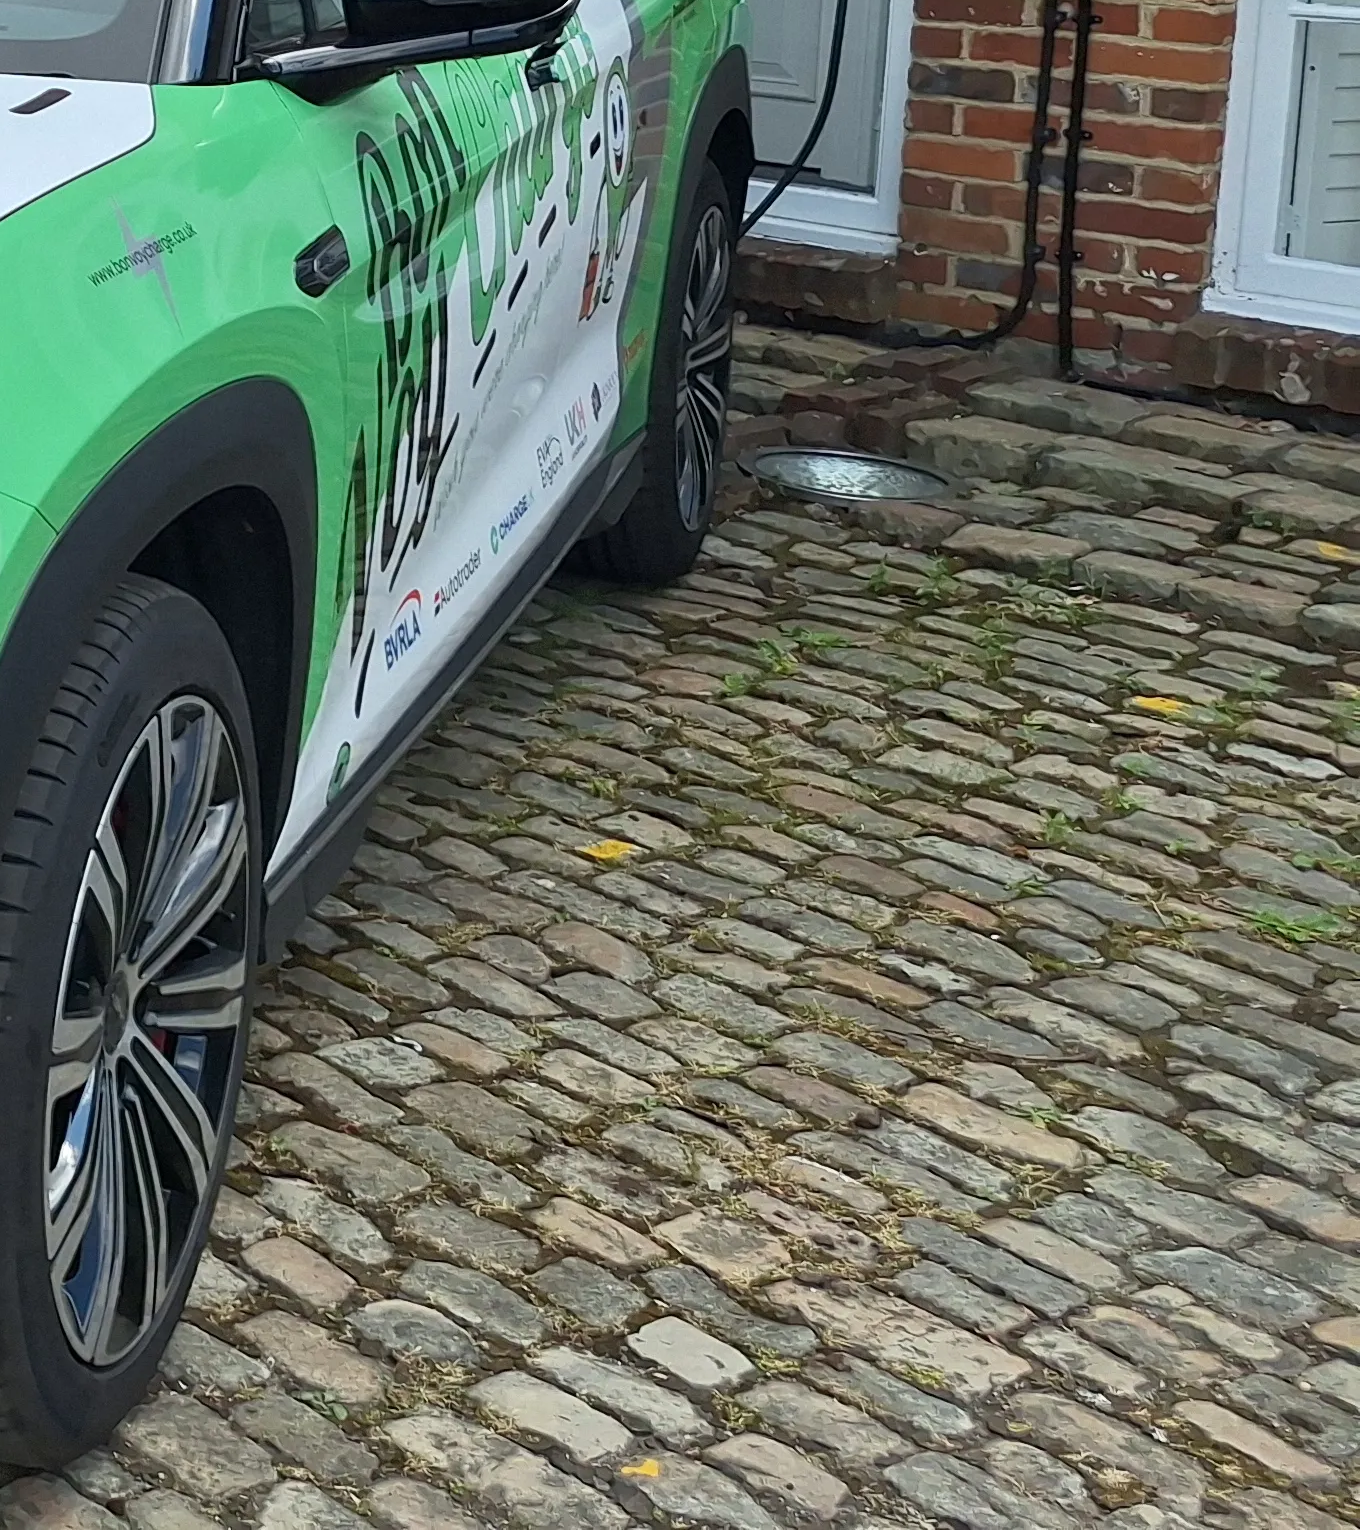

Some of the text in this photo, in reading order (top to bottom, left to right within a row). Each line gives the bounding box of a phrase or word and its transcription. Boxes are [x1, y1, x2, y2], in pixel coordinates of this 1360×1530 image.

[87, 221, 198, 287] www.bonvoycharge.co.uk
[439, 548, 482, 609] Autotrader
[383, 610, 422, 671] BVRLA
